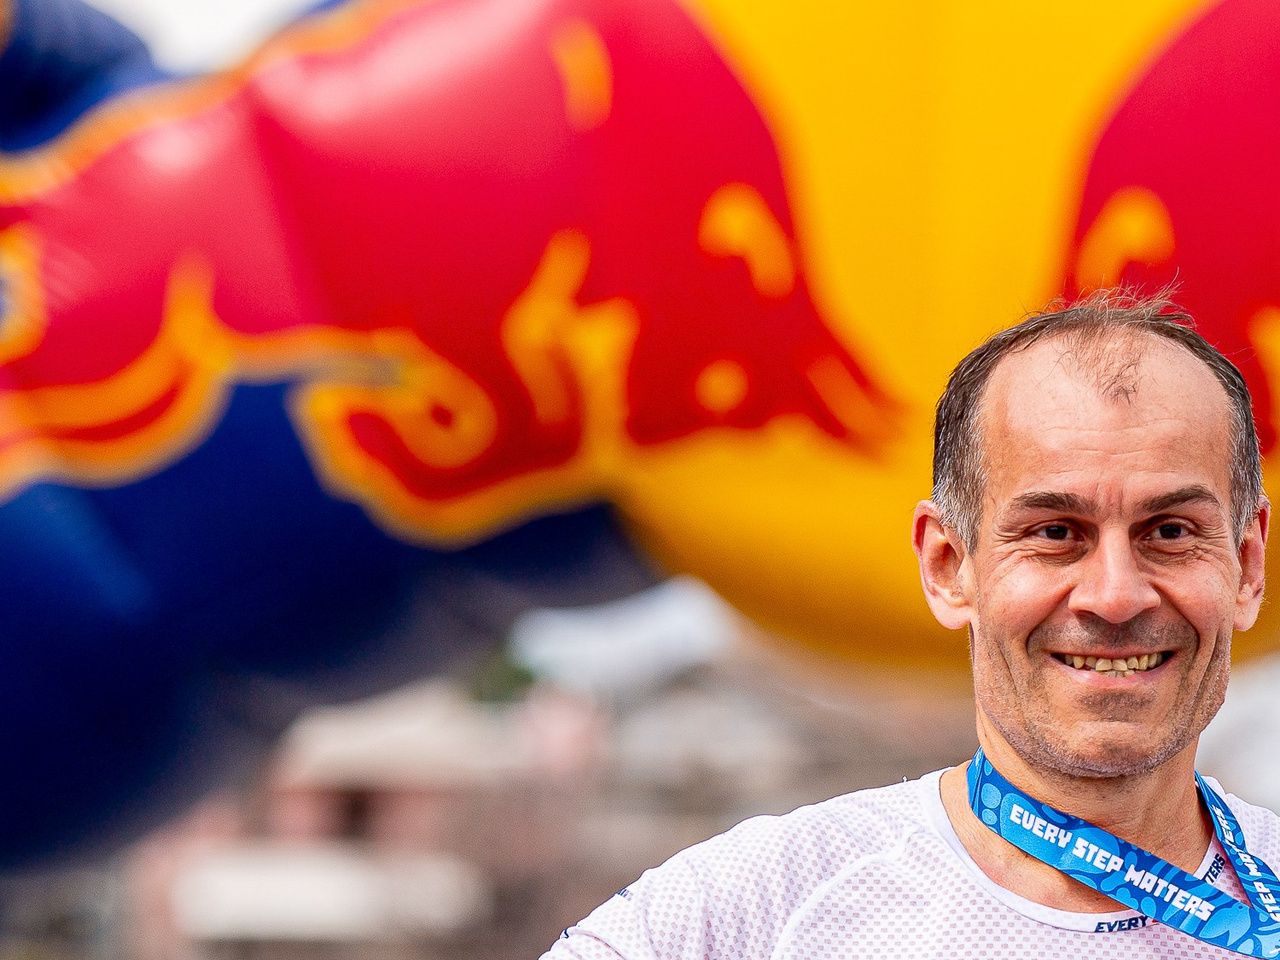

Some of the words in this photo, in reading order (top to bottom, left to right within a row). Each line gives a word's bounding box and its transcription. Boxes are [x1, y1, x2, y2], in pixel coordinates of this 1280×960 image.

[1010, 803, 1073, 848] EVERY
[1072, 837, 1125, 873] STEP
[1124, 864, 1216, 922] MATTERS
[1094, 915, 1149, 933] EVERY
[1202, 853, 1226, 884] TERS
